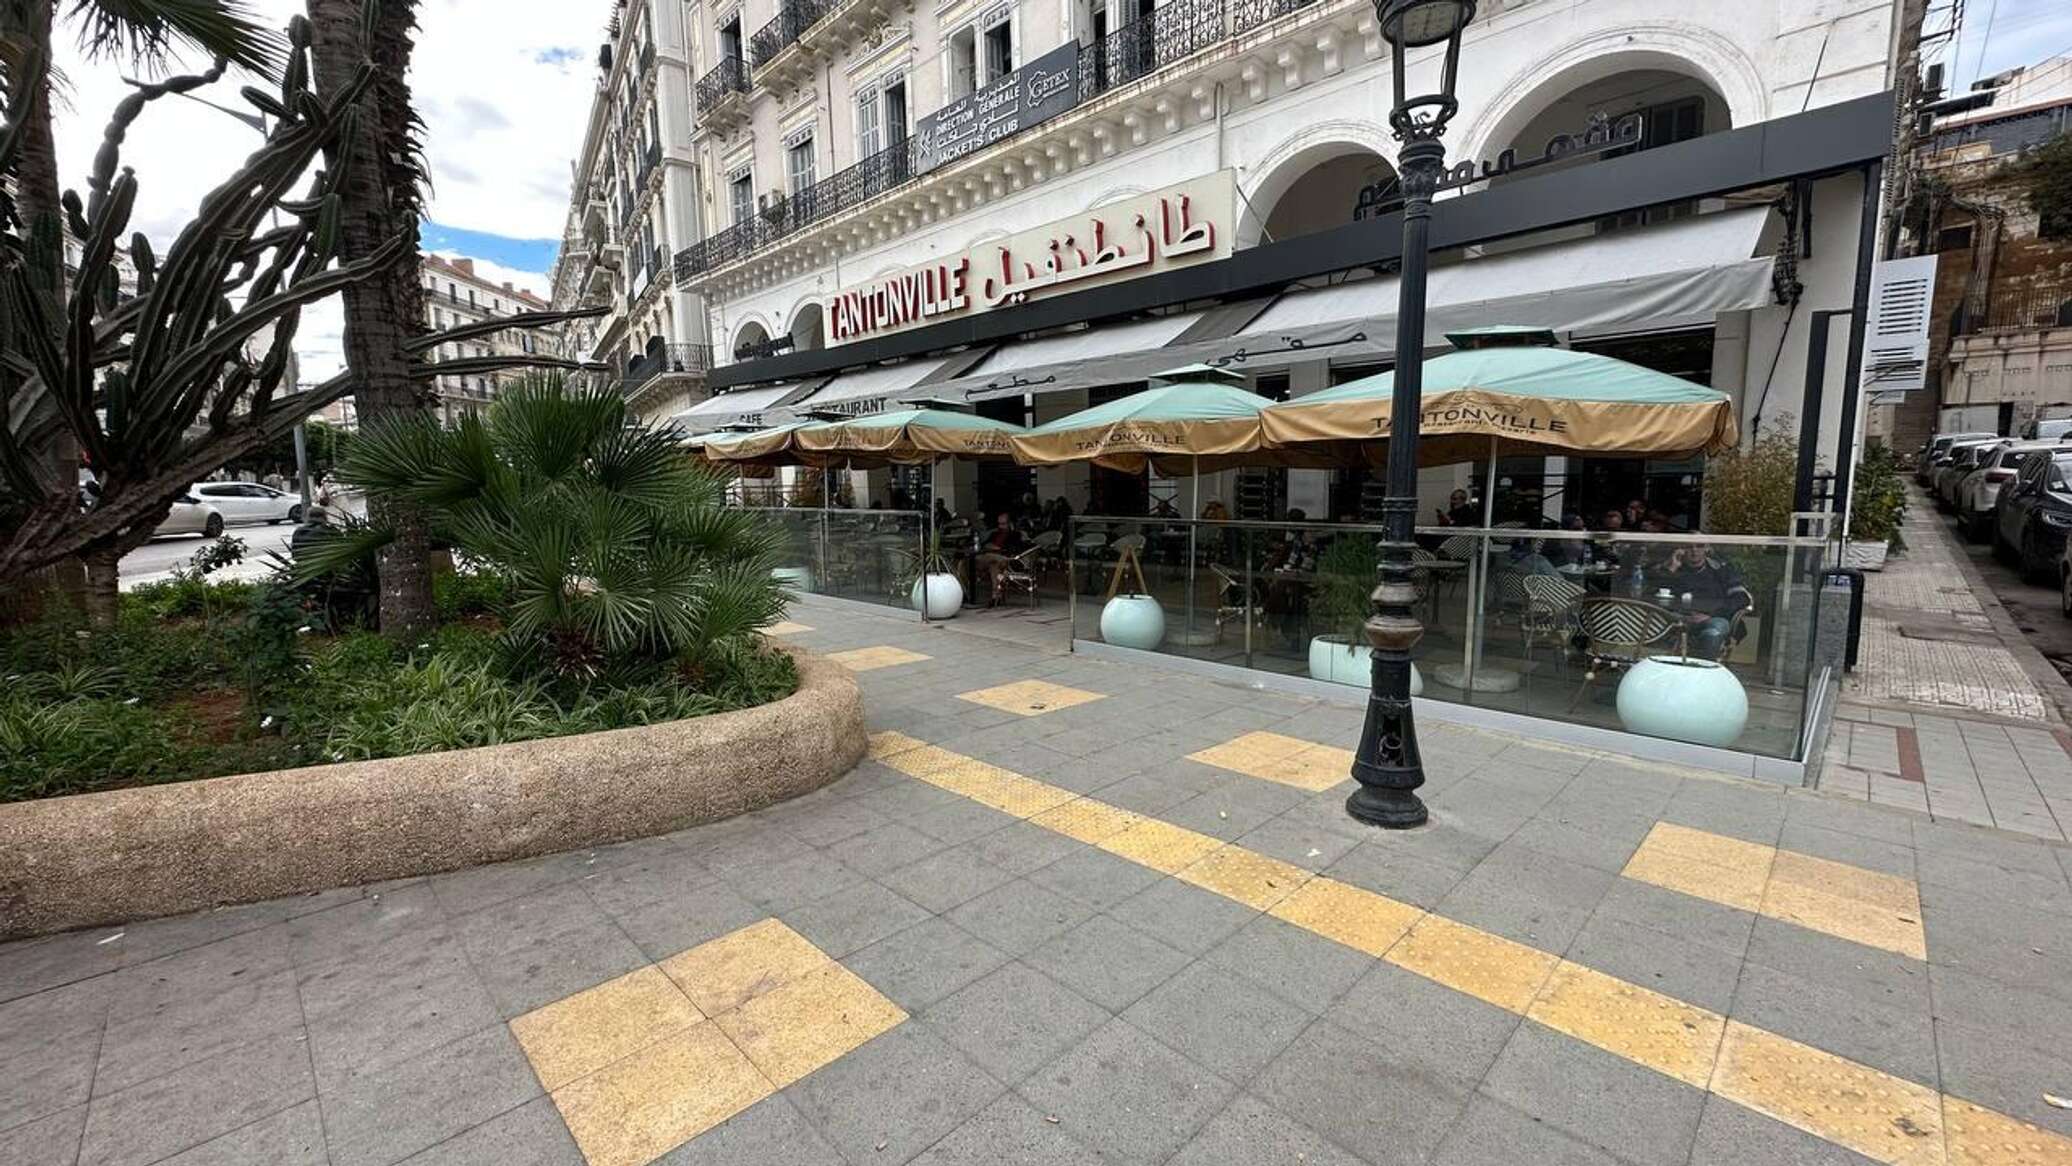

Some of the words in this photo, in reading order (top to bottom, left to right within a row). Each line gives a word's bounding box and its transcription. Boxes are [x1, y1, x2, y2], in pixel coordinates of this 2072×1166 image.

[988, 119, 1019, 141] CLUB
[983, 193, 1216, 309] طانطنفيل
[825, 257, 971, 340] TANTONVILLE
[964, 375, 1057, 401] مطعم
[812, 397, 887, 415] TAURANT
[1369, 407, 1569, 434] TTONVILLE
[1075, 431, 1187, 451] TANONVILLE
